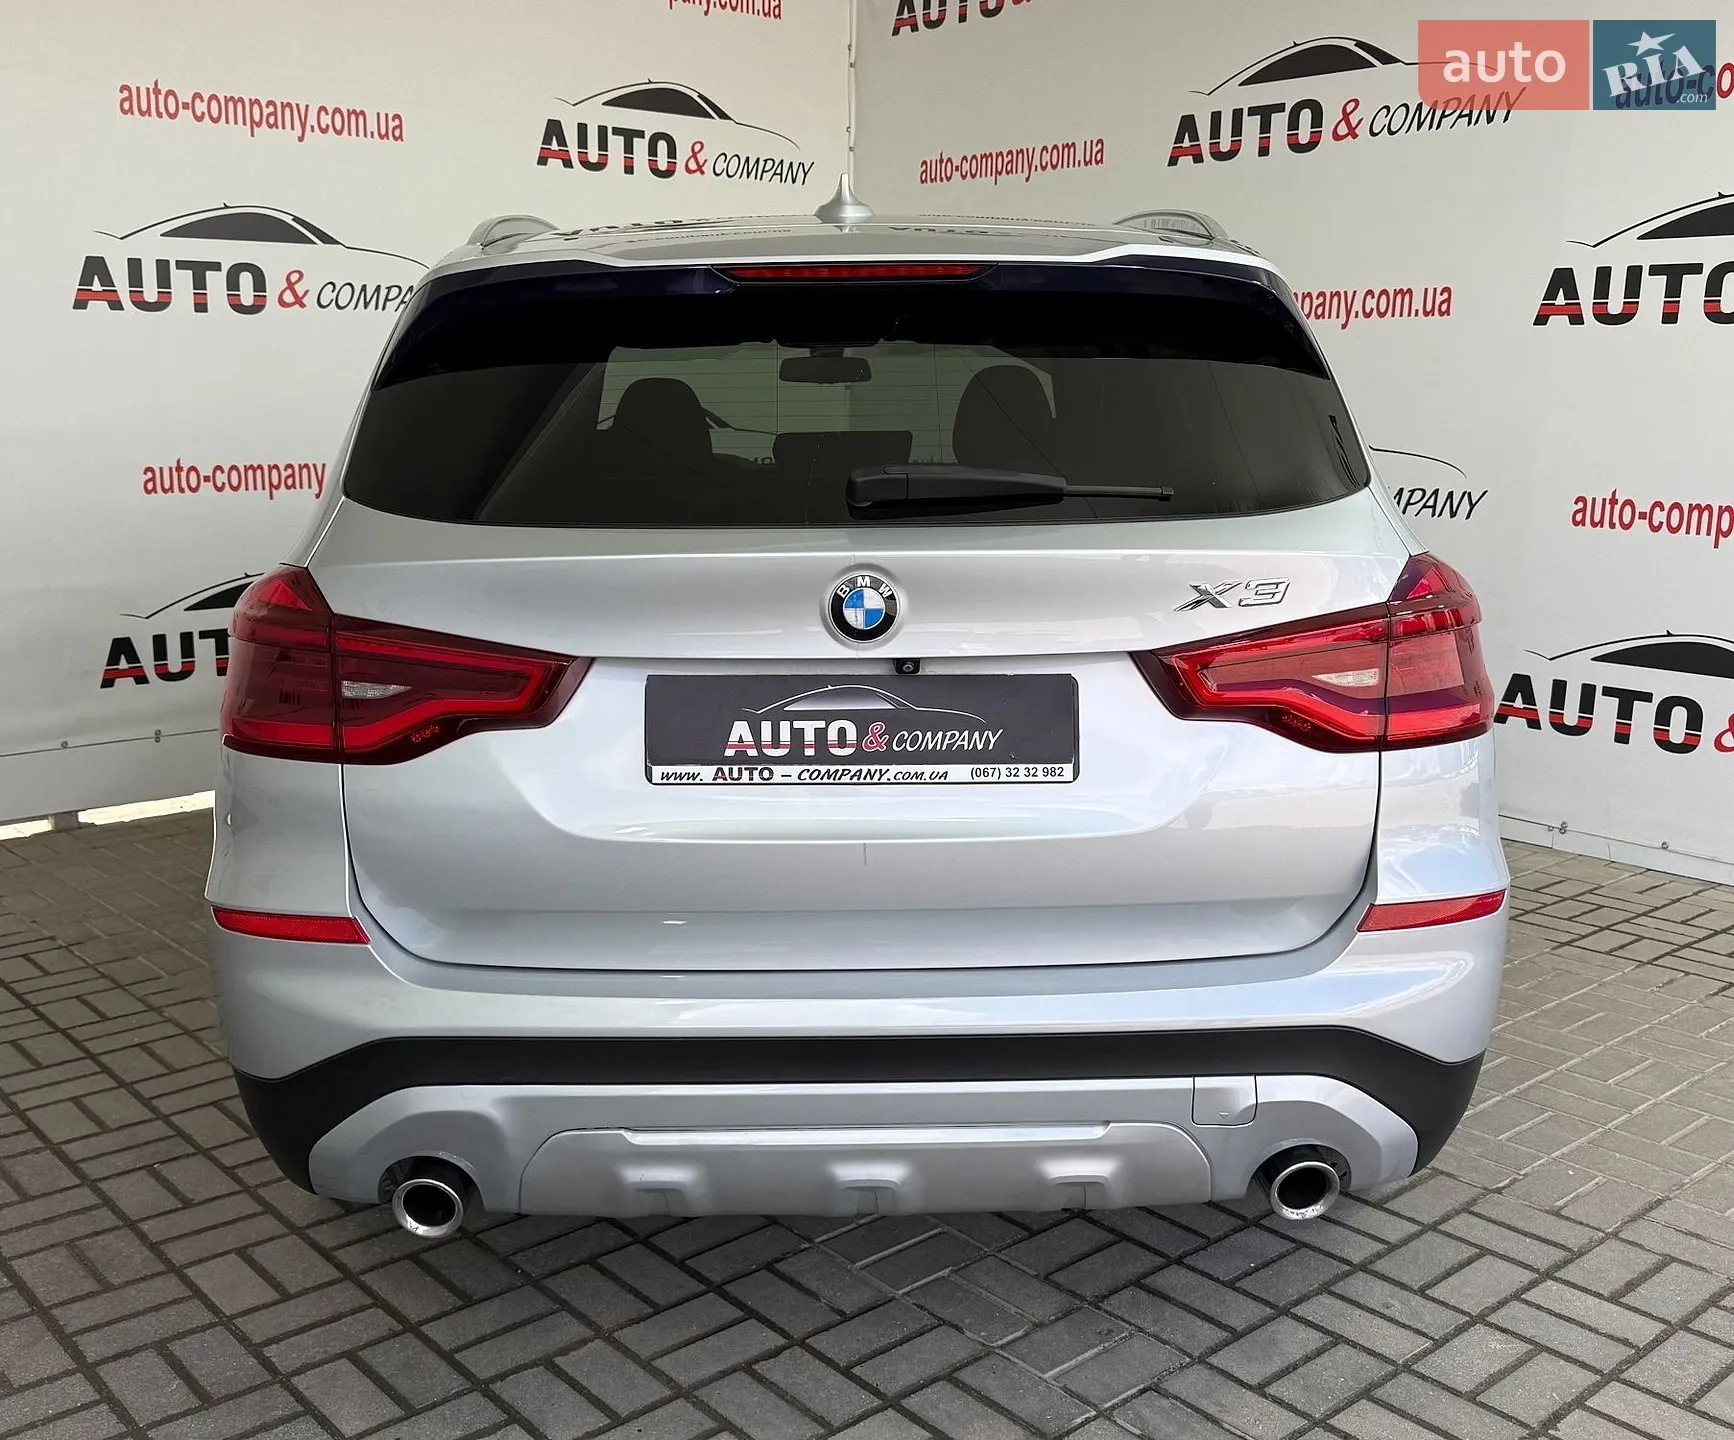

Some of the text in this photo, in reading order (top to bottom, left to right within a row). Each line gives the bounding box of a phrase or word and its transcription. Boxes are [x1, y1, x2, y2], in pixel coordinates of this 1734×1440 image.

[118, 79, 405, 142] auto-company.com.ua
[1167, 87, 1528, 167] AUTO & COMPANY
[537, 118, 815, 186] AUTO & COMPANY
[919, 137, 1105, 186] auto-company.com.ua
[72, 255, 267, 316] AUTO
[278, 269, 310, 309] &
[1532, 261, 1734, 326] AUTO
[142, 457, 327, 500] auto-company
[1571, 488, 1734, 549] auto-comp
[836, 575, 893, 599] BMW
[1173, 577, 1291, 612] X3
[724, 719, 1003, 757] AUTO & COMPANY
[1493, 673, 1704, 754] AUTO
[712, 766, 774, 782] AUTO
[970, 766, 1064, 780] (067) 32 32 982
